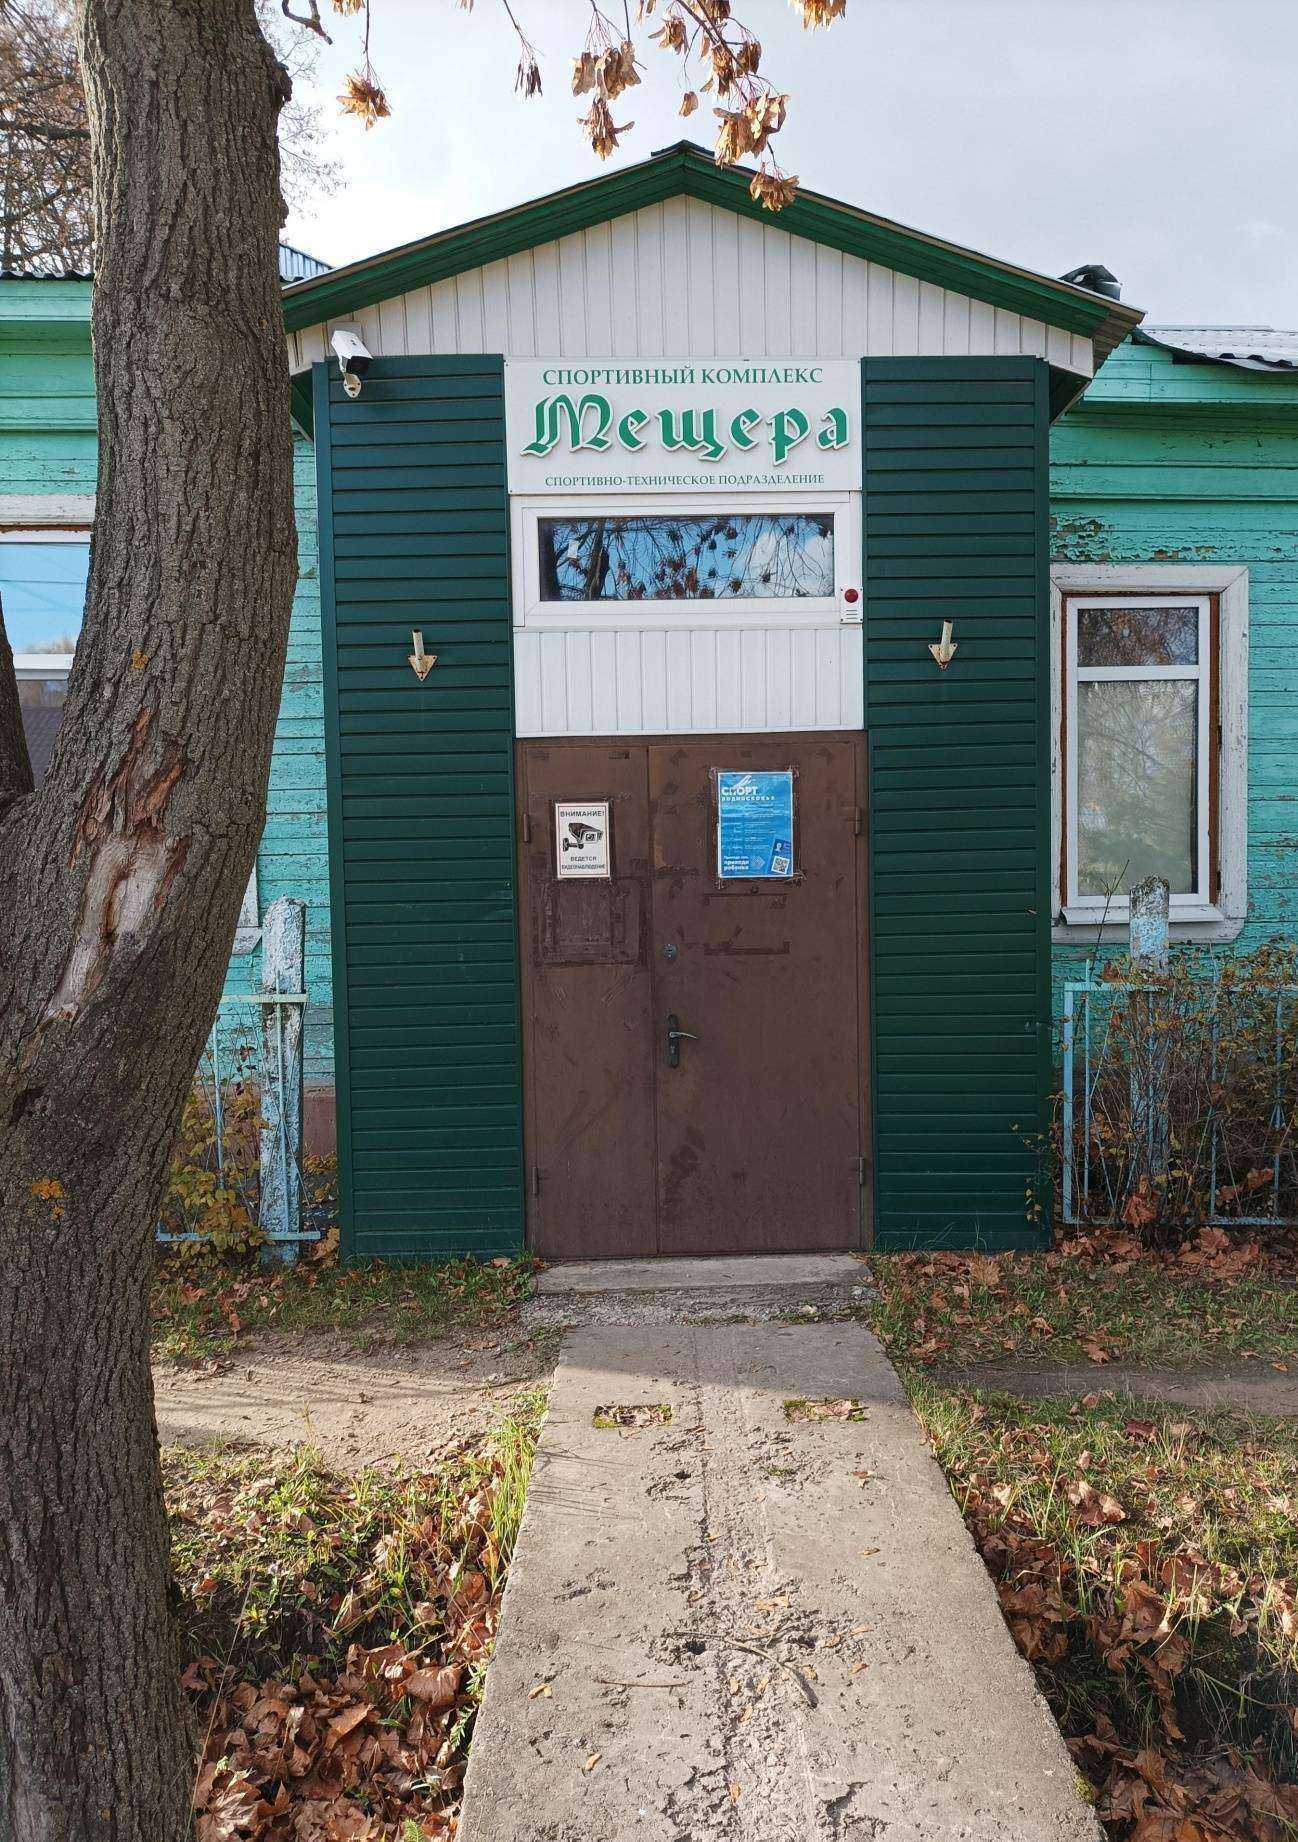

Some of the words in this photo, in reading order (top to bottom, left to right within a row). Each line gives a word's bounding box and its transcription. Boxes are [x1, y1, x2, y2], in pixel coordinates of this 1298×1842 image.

[542, 364, 695, 386] СПОРТИВНЫЙ
[701, 367, 823, 385] КОМПЛЕКС
[519, 393, 849, 467] Мещера
[545, 474, 716, 488] СПОРТИВНО-ТЕХНИЧЕСКОЕ
[718, 473, 825, 486] ПОДРАЗДЕЛЕНИЕ
[721, 786, 759, 796] СПОРТ
